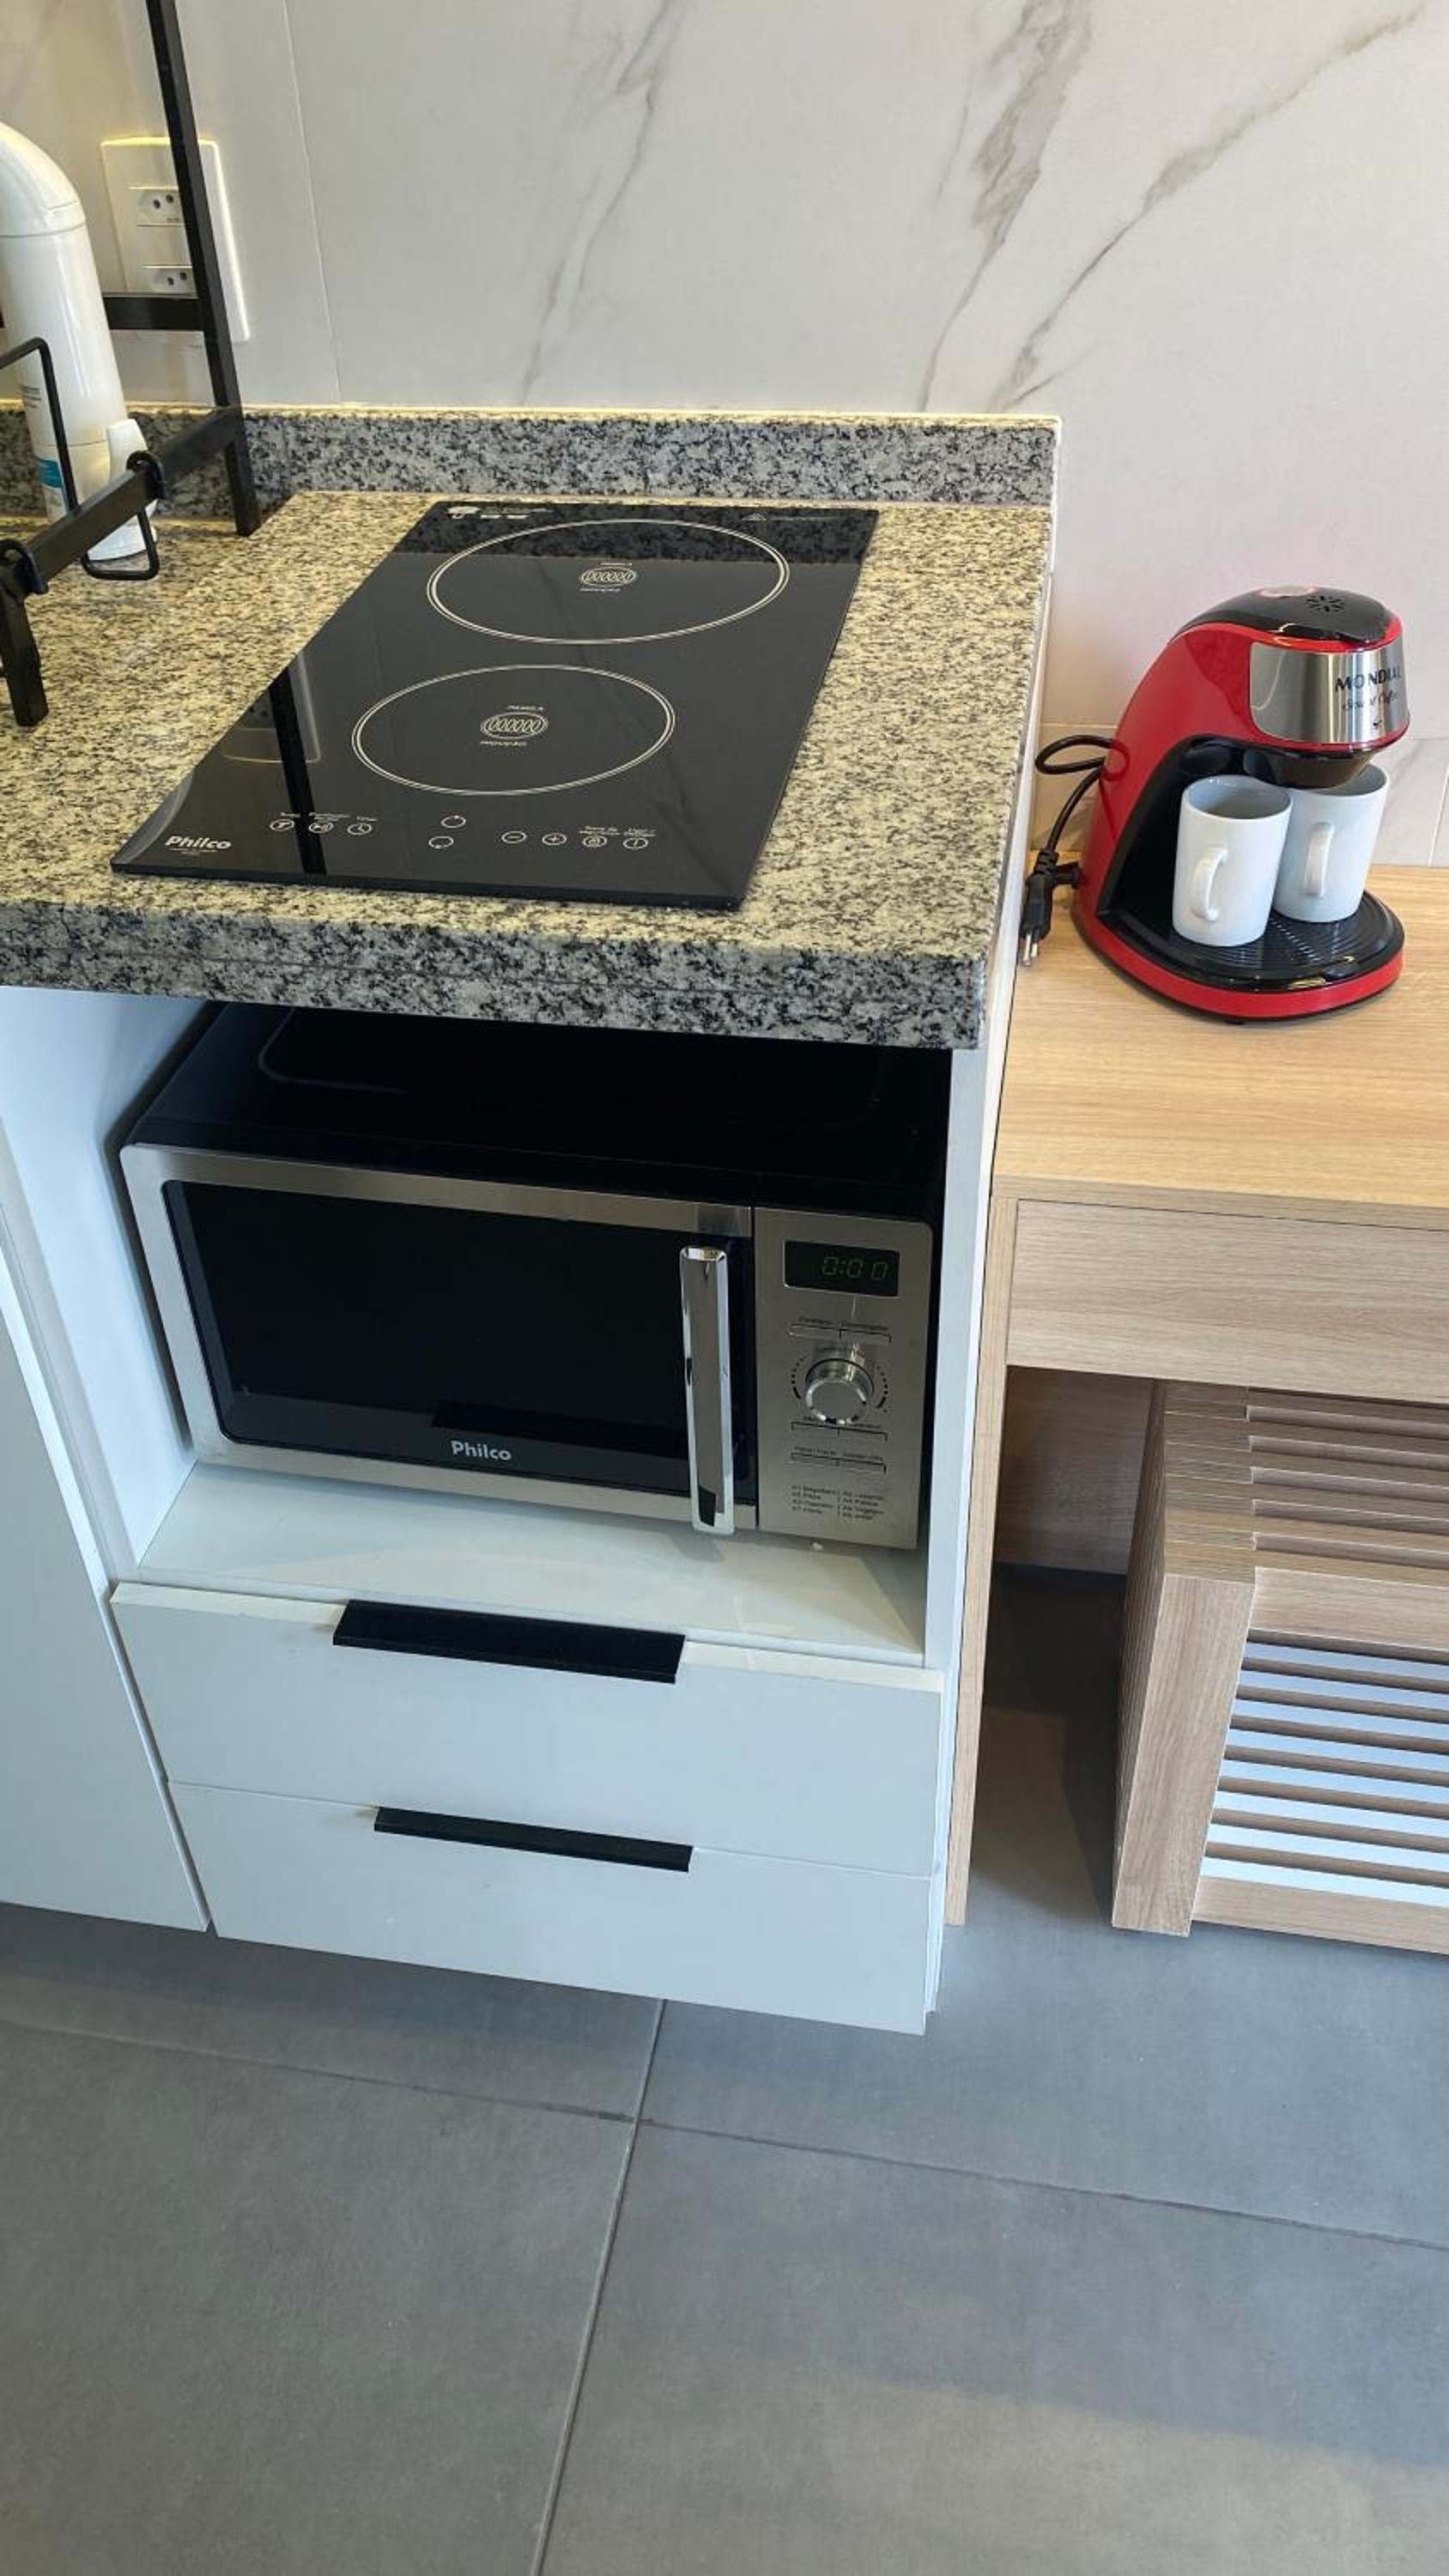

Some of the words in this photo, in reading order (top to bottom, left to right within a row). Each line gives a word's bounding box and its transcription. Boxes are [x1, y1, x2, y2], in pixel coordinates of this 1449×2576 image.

[1335, 666, 1402, 692] MONDIAL
[164, 835, 233, 850] Philco
[822, 1255, 889, 1282] 0:00
[450, 1439, 512, 1461] Philco
